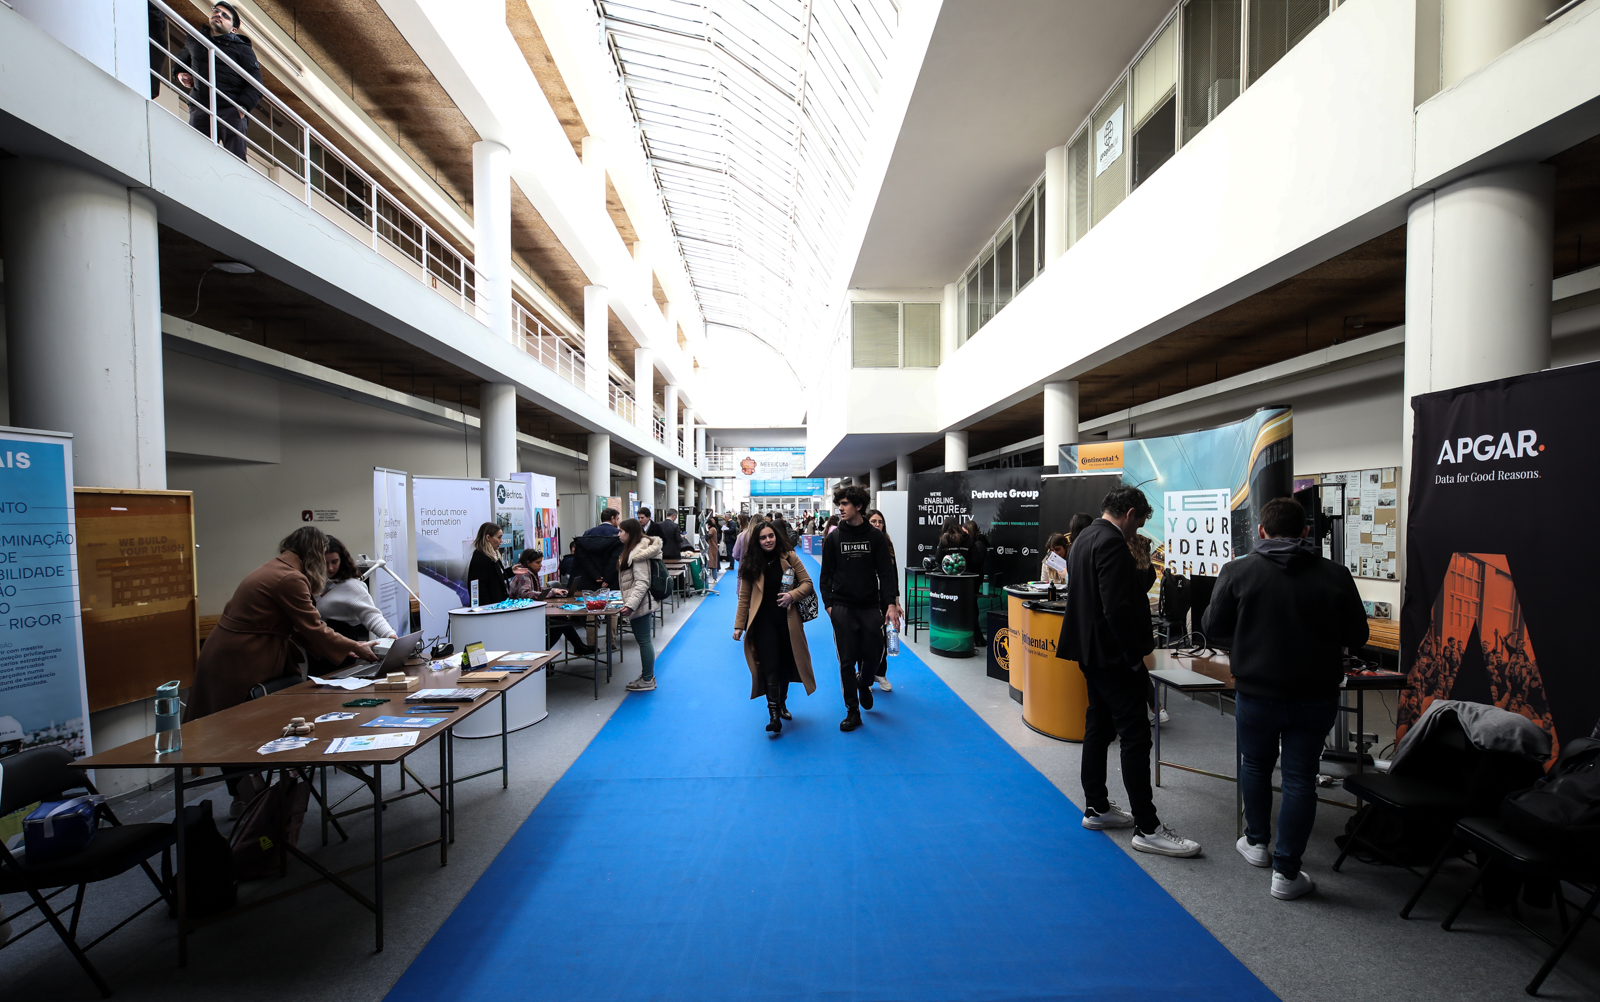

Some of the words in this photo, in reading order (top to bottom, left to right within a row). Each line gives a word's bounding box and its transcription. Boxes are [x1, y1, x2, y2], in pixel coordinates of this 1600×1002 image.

[1437, 429, 1545, 465] APGAR.
[1435, 475, 1455, 484] Data
[1456, 473, 1469, 483] for
[1470, 470, 1495, 482] Good
[1498, 470, 1542, 481] Reasons.
[971, 490, 1008, 499] Petrotec
[1009, 489, 1039, 500] Group
[924, 497, 954, 505] ENABLING
[1168, 493, 1229, 511] LET
[420, 508, 436, 516] Find
[437, 508, 449, 516] out
[450, 508, 467, 516] more
[928, 504, 960, 514] FUTURE
[421, 518, 461, 526] information
[928, 515, 975, 525] MOITY
[1168, 517, 1229, 534] YOUR
[421, 528, 440, 536] here!
[0, 531, 74, 548] MINAÇÃO
[119, 538, 135, 547] WE
[138, 536, 168, 545] BUILD
[119, 546, 149, 556] YOUR
[151, 543, 185, 554] VISION
[1168, 538, 1230, 558] IDEAS
[9, 613, 61, 630] RIGOR
[0, 654, 22, 662] ovação
[0, 660, 19, 668] cerias
[0, 680, 48, 691] ustentabilidade.
